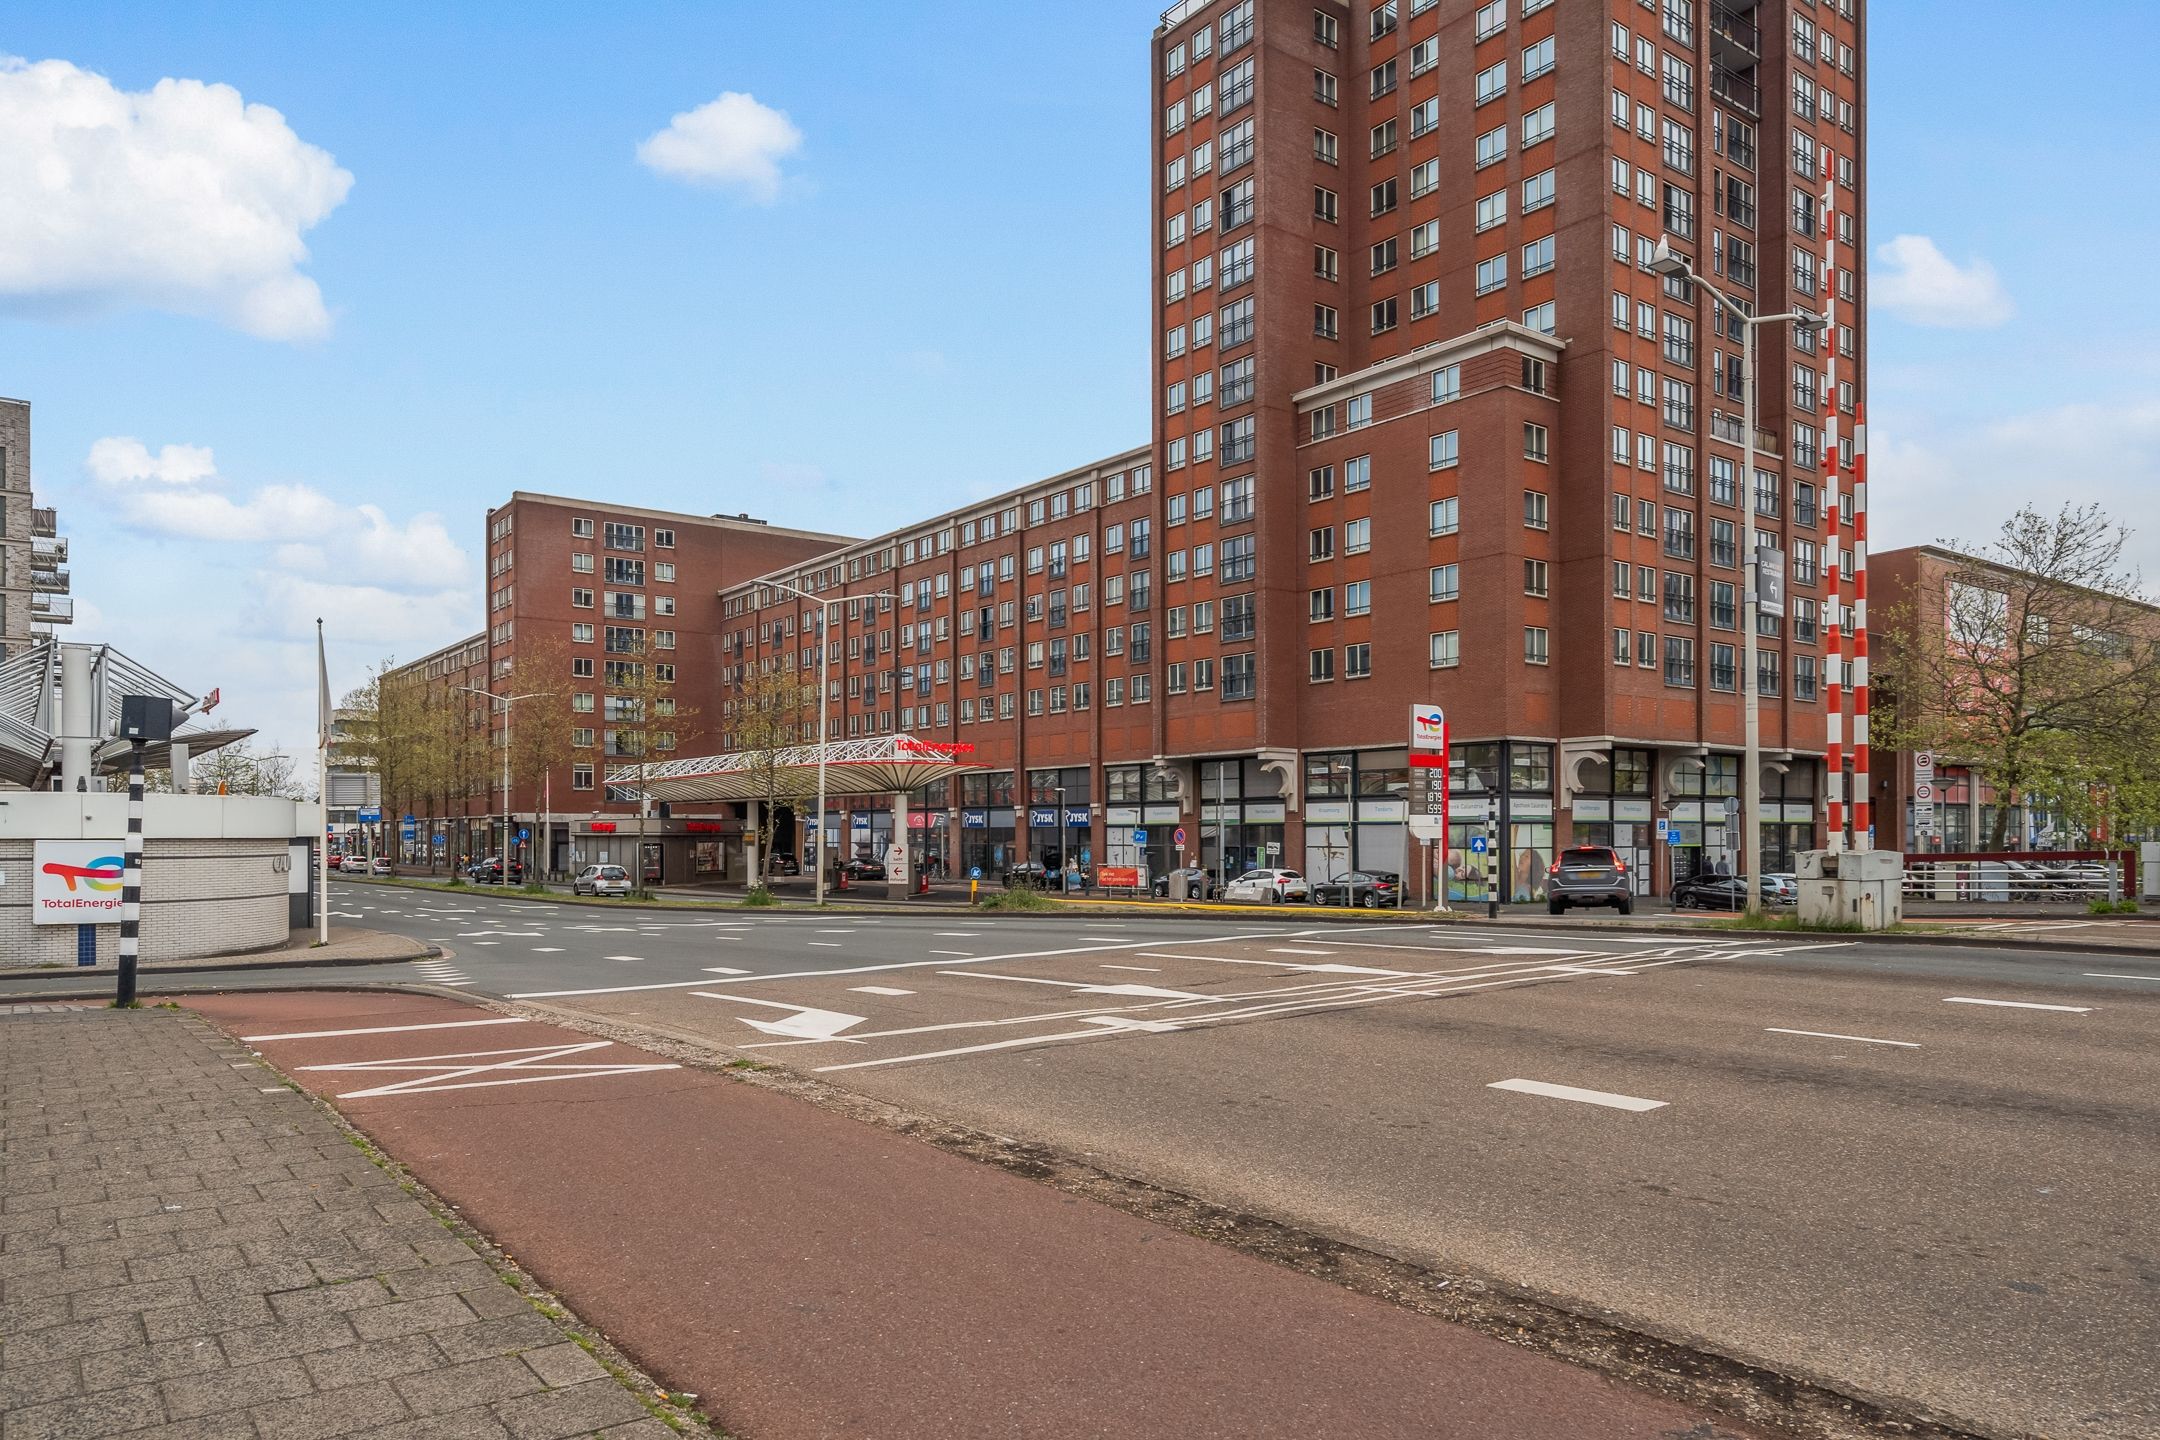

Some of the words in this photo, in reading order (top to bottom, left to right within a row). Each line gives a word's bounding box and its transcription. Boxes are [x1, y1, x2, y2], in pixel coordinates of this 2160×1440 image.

[896, 739, 975, 755] TotalEnergies
[856, 817, 868, 825] JYSK
[968, 814, 984, 824] JYSK
[1036, 813, 1054, 823] JYSK
[1070, 812, 1088, 823] JYSK
[41, 898, 123, 910] TotalEnergie
